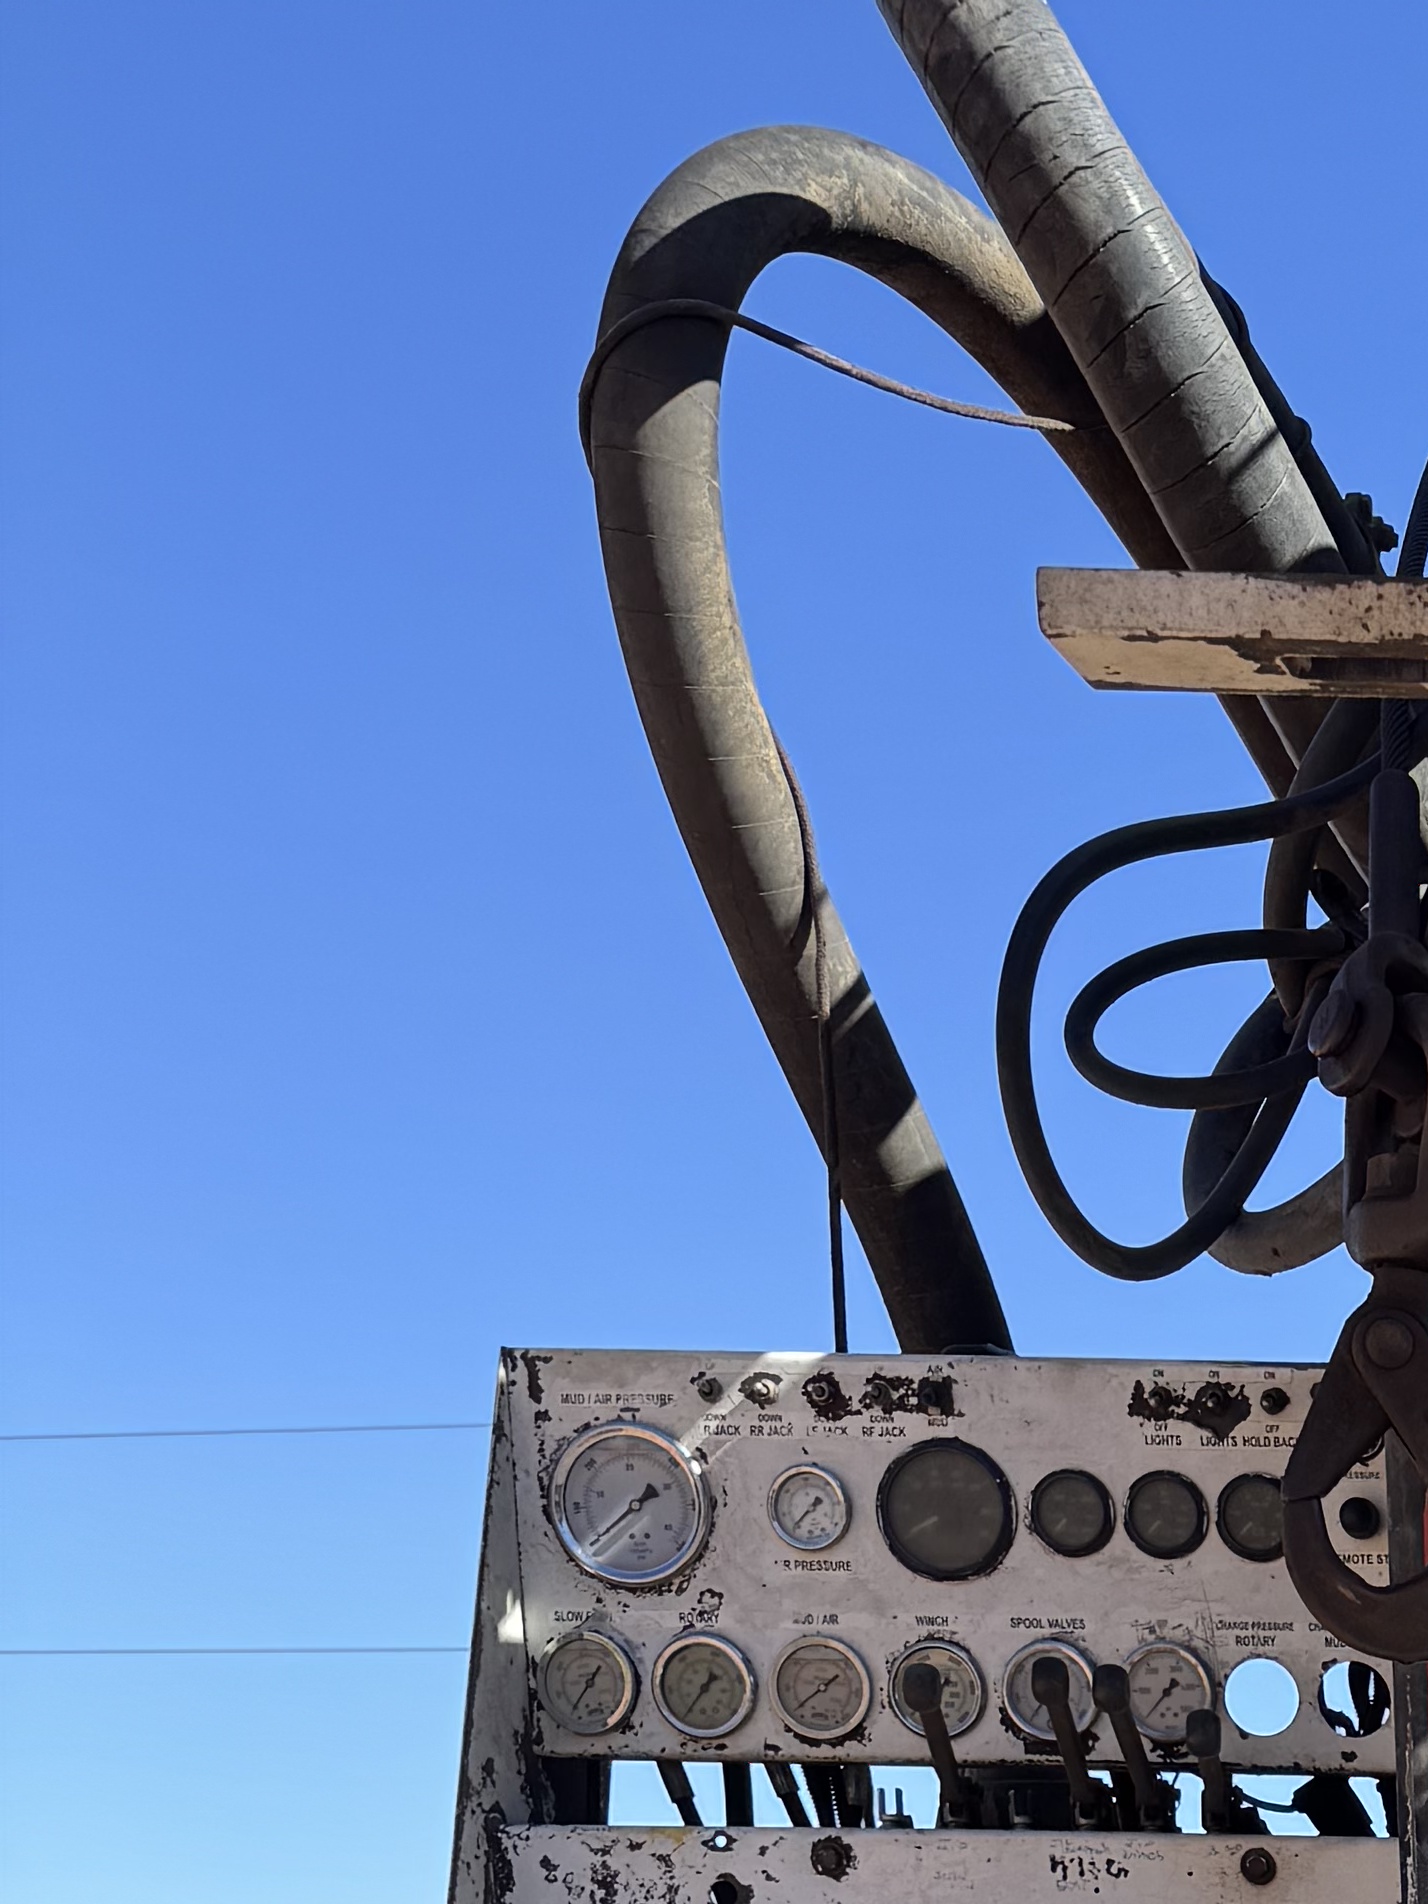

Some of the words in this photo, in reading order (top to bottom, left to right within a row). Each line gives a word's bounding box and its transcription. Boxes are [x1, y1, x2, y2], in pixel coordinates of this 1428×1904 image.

[561, 1393, 585, 1404] MUD
[595, 1394, 613, 1405] AIR
[713, 1425, 741, 1435] JACK
[750, 1425, 764, 1436] RR
[767, 1425, 793, 1436] JACK
[862, 1426, 876, 1437] RF
[879, 1426, 906, 1437] JACK
[1144, 1435, 1182, 1446] LIGHTS
[1242, 1436, 1271, 1447] HOLD
[1338, 1554, 1373, 1565] EMOTE
[794, 1560, 852, 1572] PRESSURE
[554, 1611, 583, 1622] SLOW
[822, 1614, 839, 1625] AIR
[915, 1615, 948, 1626] WINCH
[1010, 1617, 1045, 1629] SPOOL
[1048, 1618, 1086, 1630] VALVES
[1235, 1636, 1276, 1647] ROTARY
